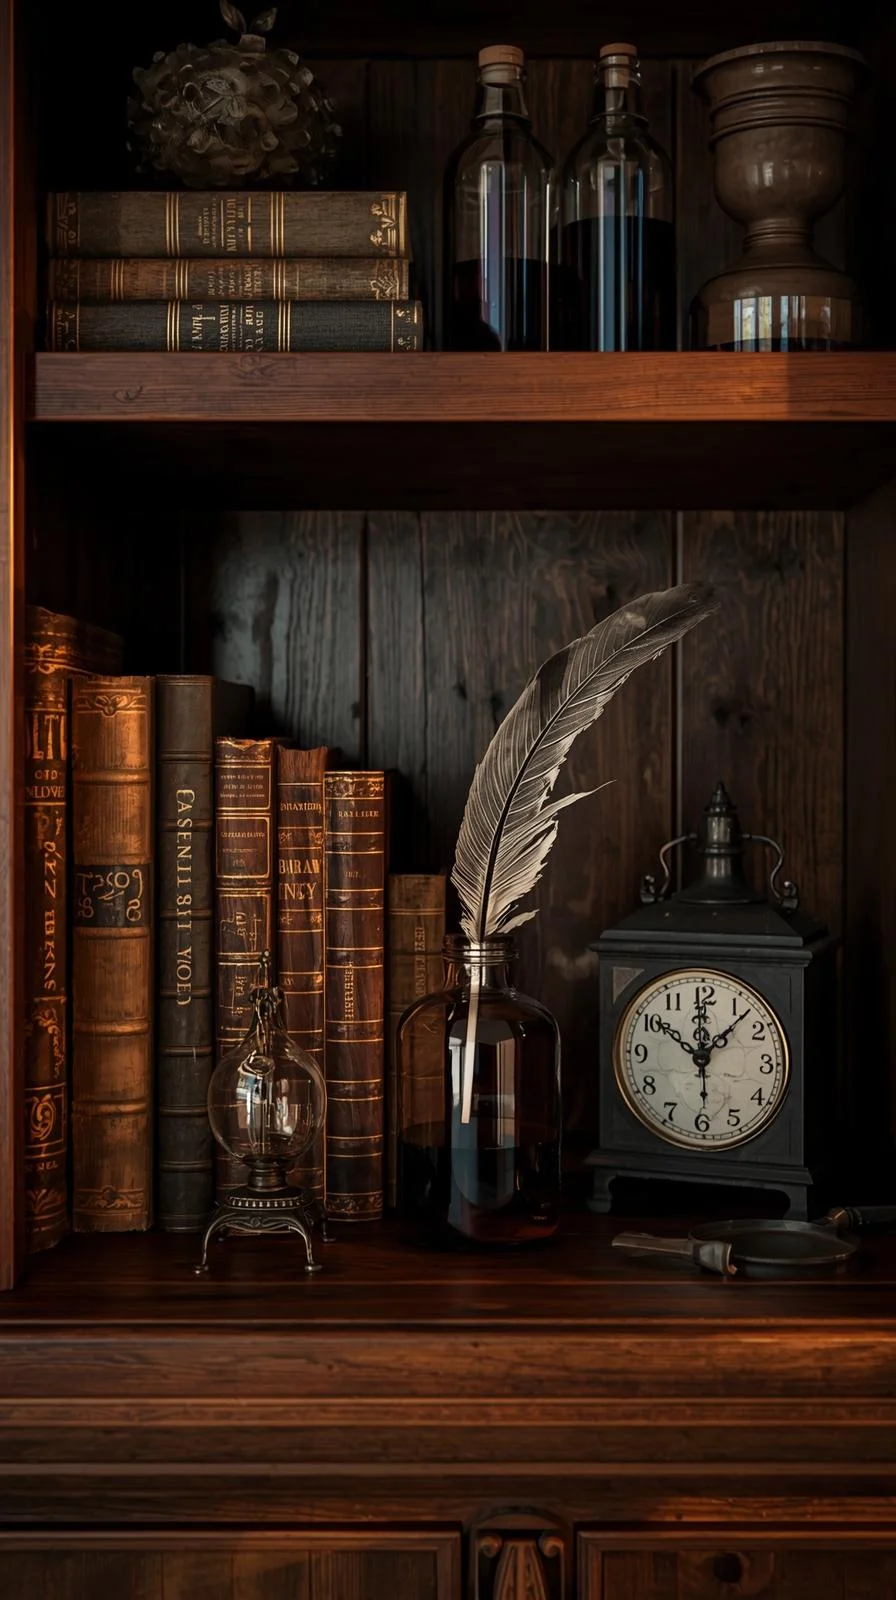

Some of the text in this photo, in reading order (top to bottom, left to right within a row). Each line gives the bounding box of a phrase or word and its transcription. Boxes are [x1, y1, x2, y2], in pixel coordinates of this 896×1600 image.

[665, 993, 681, 1011] 11
[694, 985, 717, 1005] 12
[731, 997, 738, 1016] 1
[644, 1013, 662, 1032] 10
[752, 1021, 766, 1041] 2
[634, 1044, 648, 1064] 9
[759, 1053, 774, 1074] 3
[642, 1075, 656, 1096] 8
[750, 1087, 765, 1106] 4
[663, 1102, 678, 1122] 7
[727, 1109, 741, 1127] 5
[694, 1114, 710, 1133] 6
